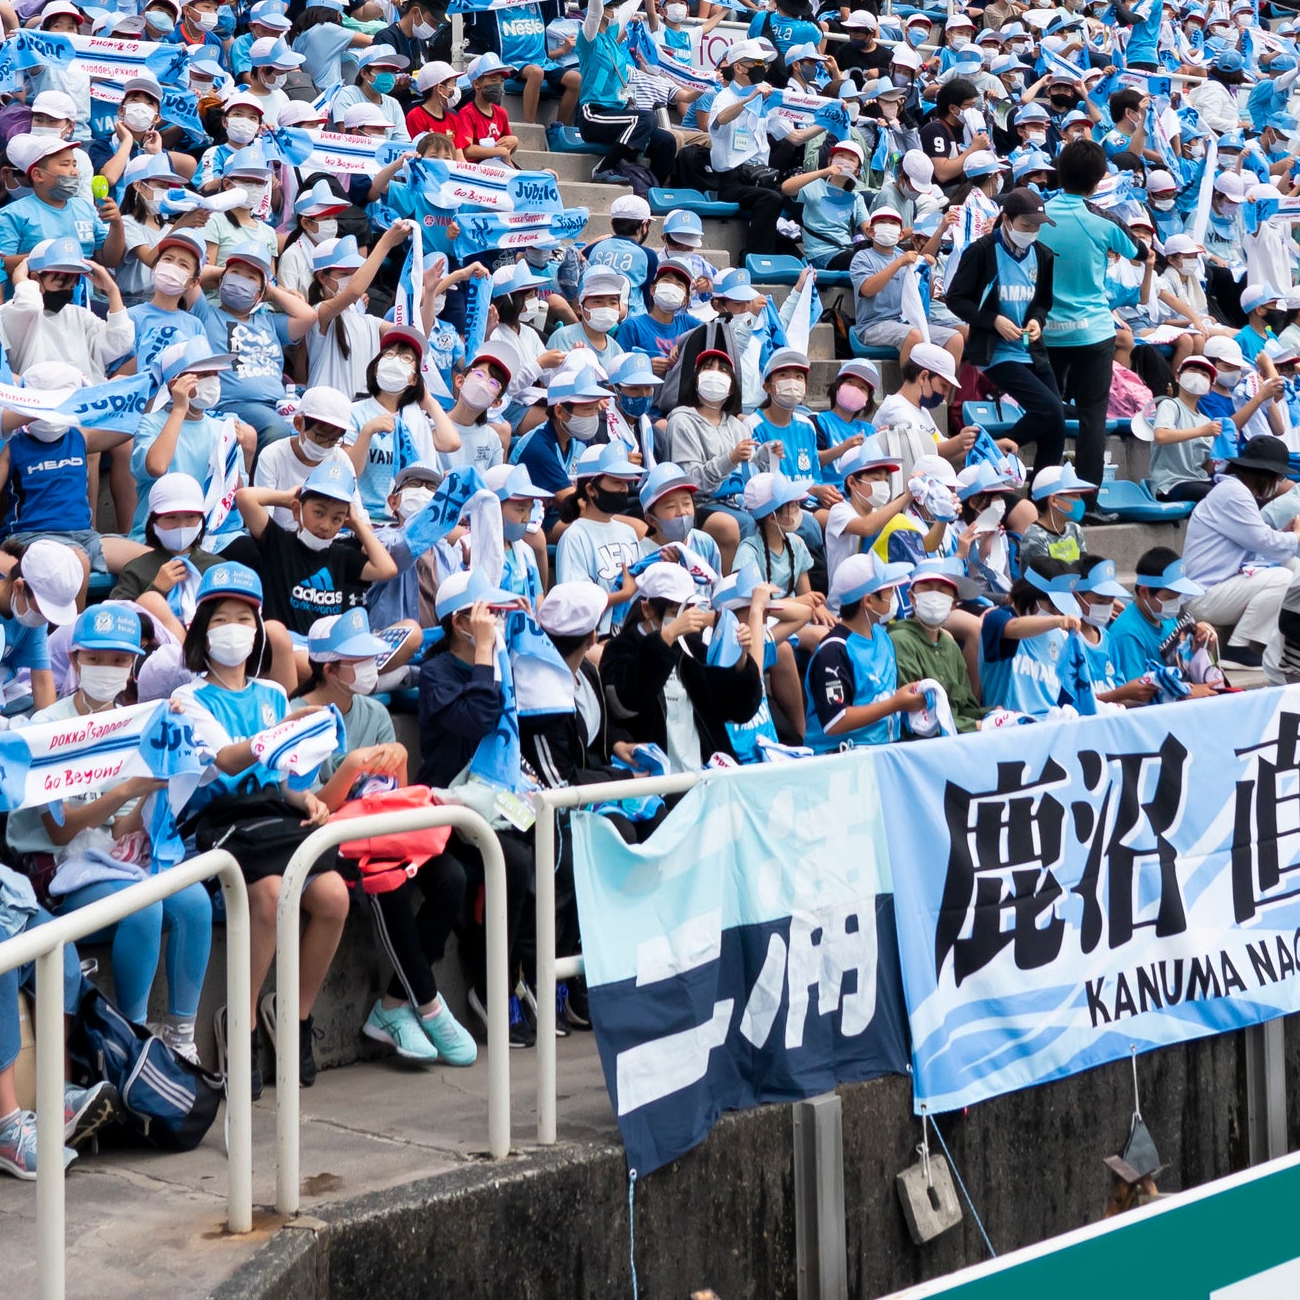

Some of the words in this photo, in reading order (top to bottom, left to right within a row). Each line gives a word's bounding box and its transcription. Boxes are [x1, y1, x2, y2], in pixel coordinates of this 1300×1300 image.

[515, 181, 559, 202] Júbilo
[595, 251, 634, 272] sala
[27, 456, 84, 475] HEAD
[292, 585, 343, 605] adidas
[44, 772, 62, 792] Go
[64, 759, 124, 786] Beyond
[936, 733, 1189, 986] 鹿沼
[1084, 944, 1243, 1028] KANUMA
